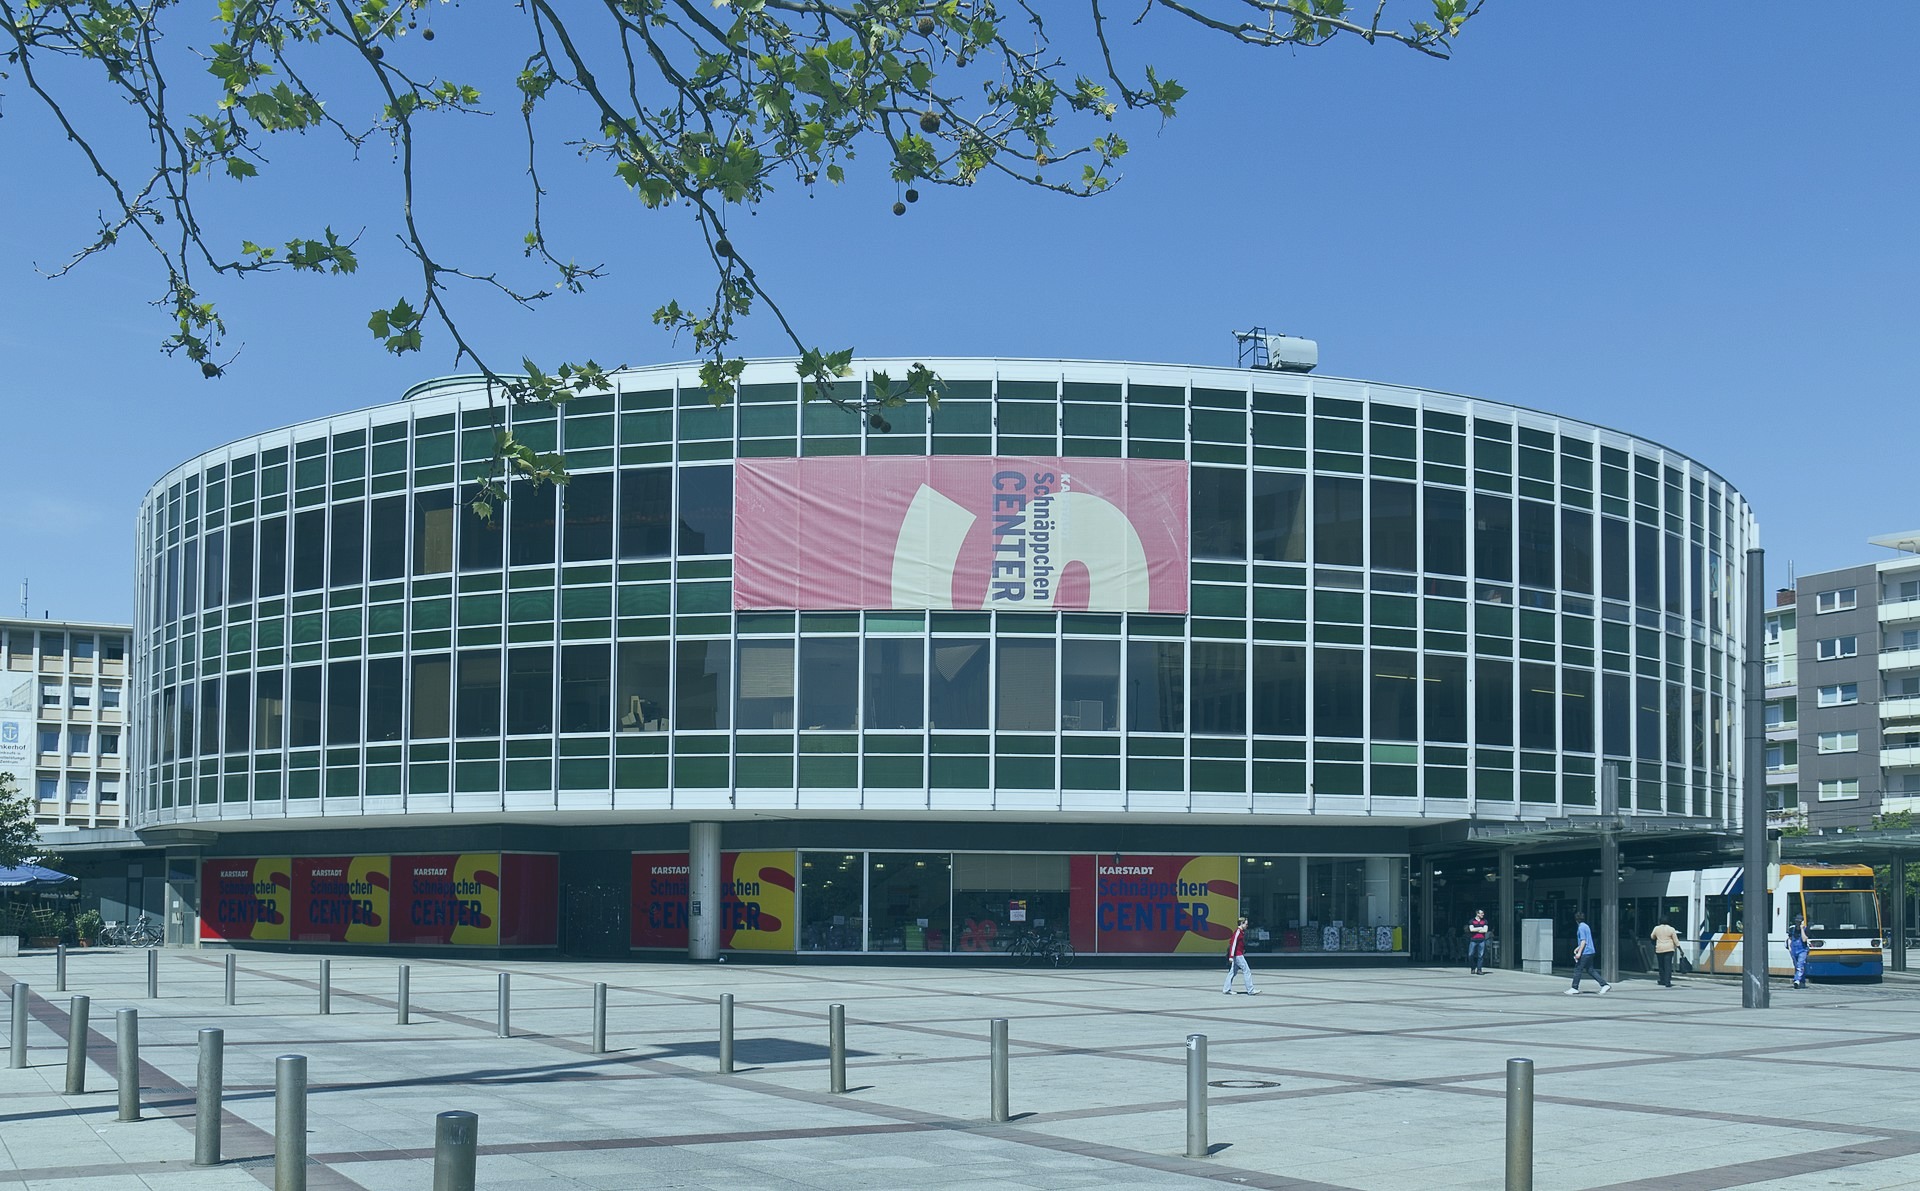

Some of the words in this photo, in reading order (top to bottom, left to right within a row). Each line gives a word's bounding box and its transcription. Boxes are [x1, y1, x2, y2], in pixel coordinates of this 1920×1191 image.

[991, 470, 1027, 602] CENTER
[1028, 472, 1056, 600] Schnäppchen
[311, 869, 343, 877] KARSTADT
[413, 868, 448, 876] KARSTADT
[1099, 866, 1154, 875] KARSTADT
[219, 880, 277, 897] Schnäppchen
[310, 879, 373, 896] Schnäppchen
[412, 878, 482, 898] Schnäppchen
[1099, 878, 1209, 899] Schnäppchen
[218, 899, 277, 923] CENTER
[309, 899, 373, 925] CENTER
[412, 899, 482, 926] CENTER
[1099, 902, 1210, 932] CENTER
